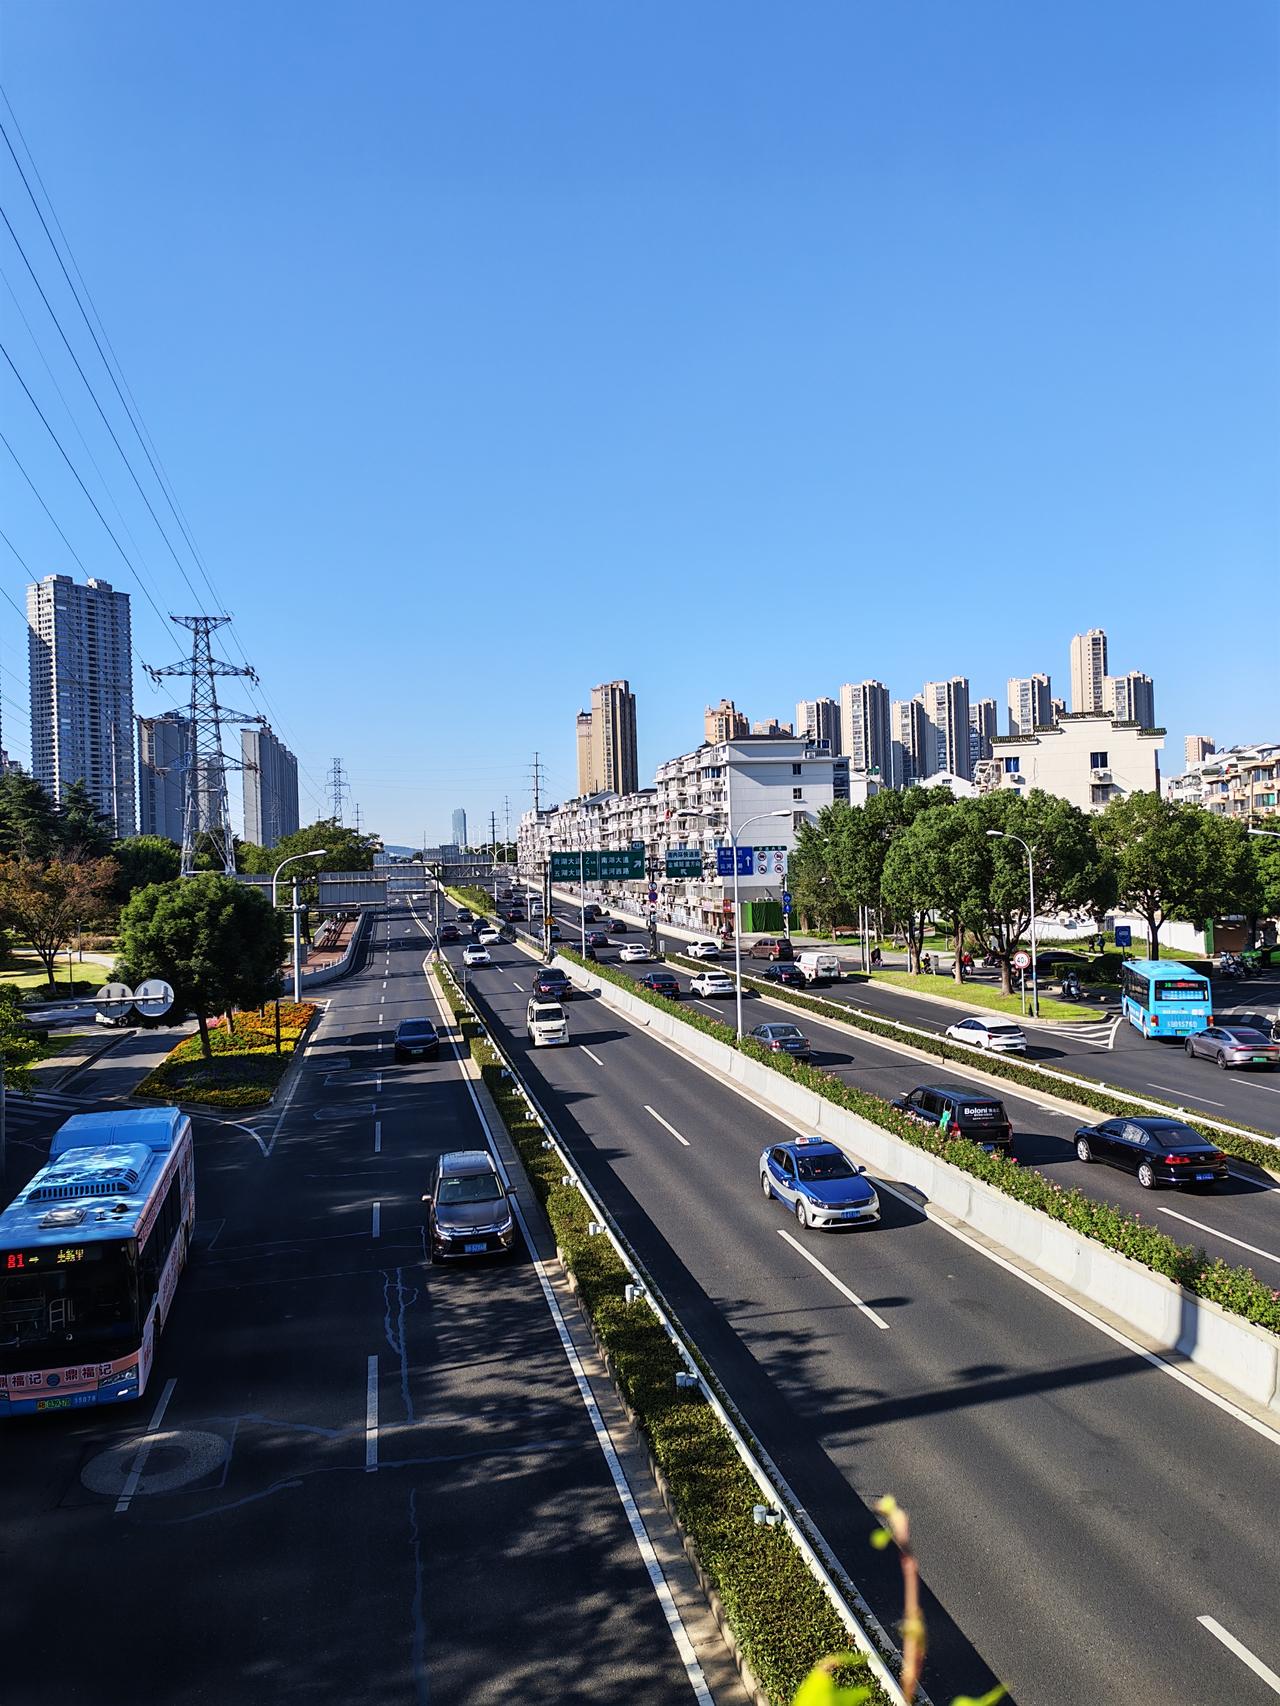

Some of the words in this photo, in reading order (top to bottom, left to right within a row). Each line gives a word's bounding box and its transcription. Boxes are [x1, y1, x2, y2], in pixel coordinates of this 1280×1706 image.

[964, 1107, 988, 1115] Boloni
[64, 1363, 113, 1381] 鼎福记
